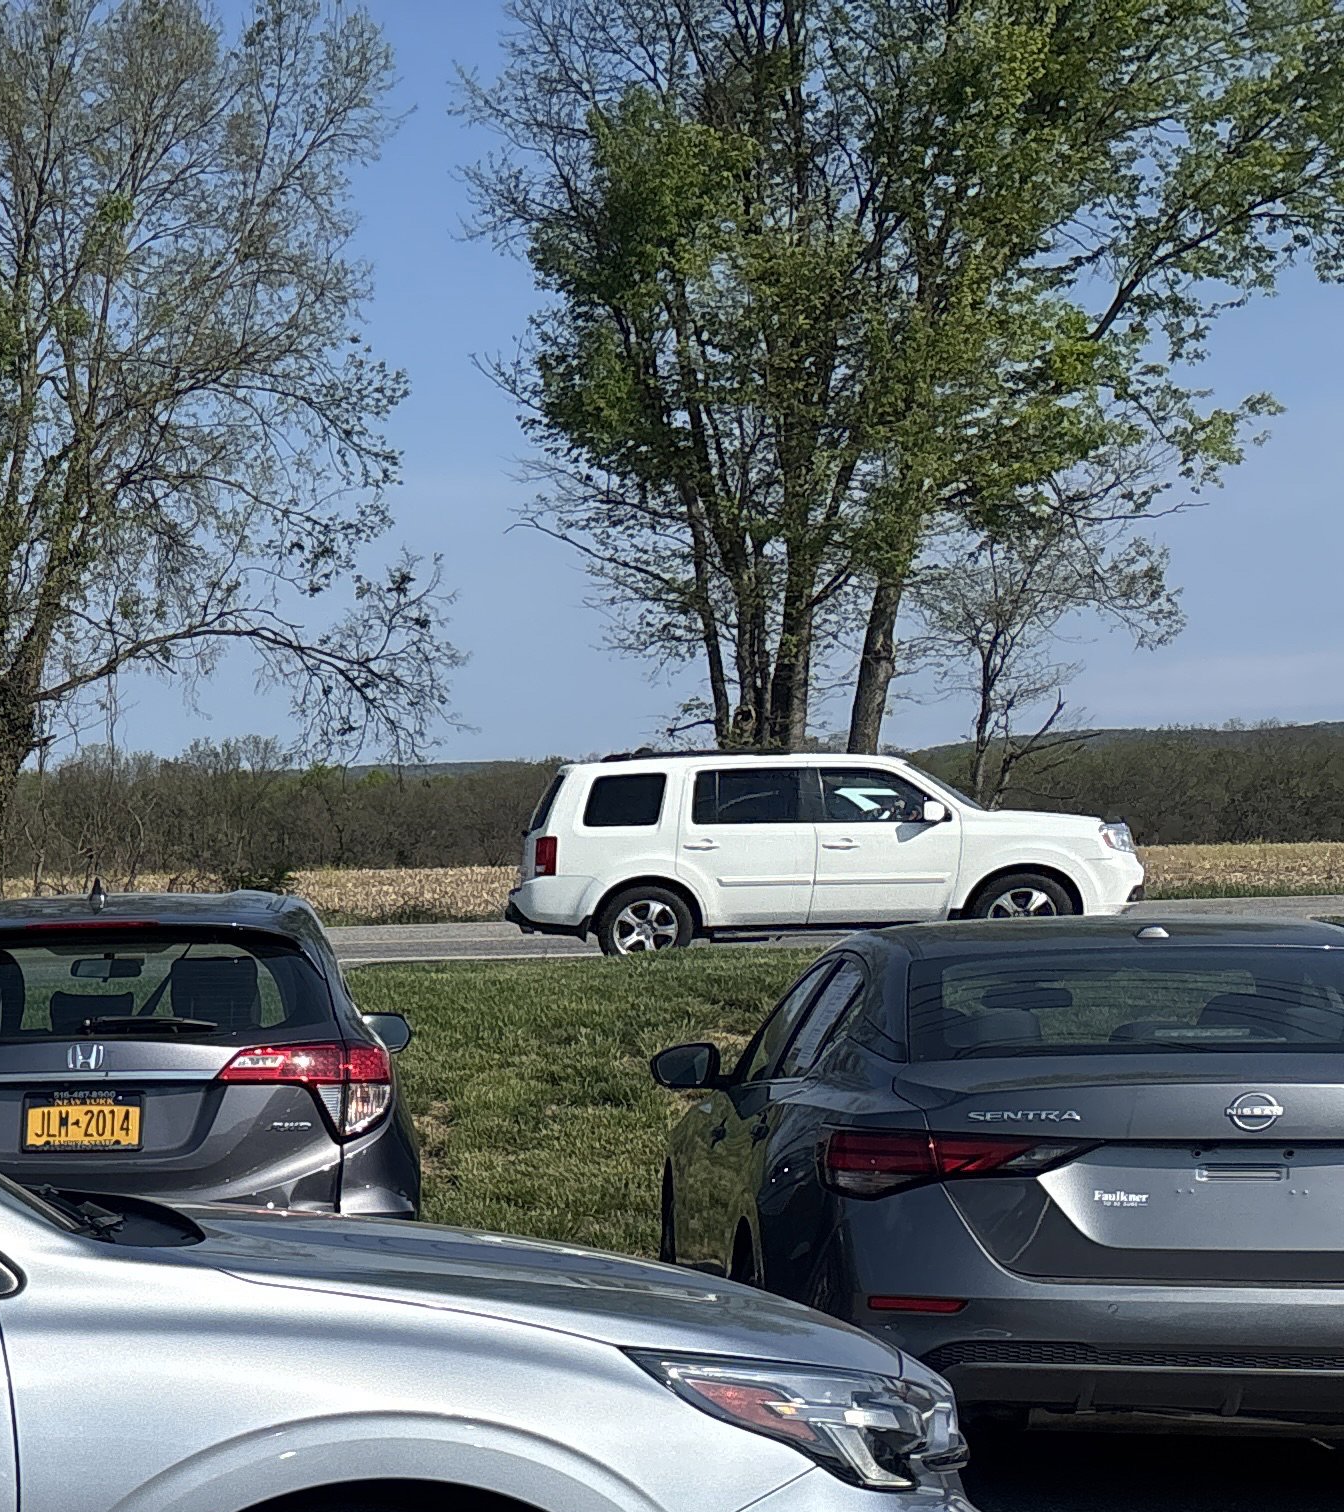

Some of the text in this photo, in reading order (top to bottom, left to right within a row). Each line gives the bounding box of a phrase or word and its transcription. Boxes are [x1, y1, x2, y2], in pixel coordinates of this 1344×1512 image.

[967, 1110, 1081, 1122] SENTRA
[1226, 1106, 1284, 1116] NISSAN
[1093, 1190, 1149, 1202] Faulkner
